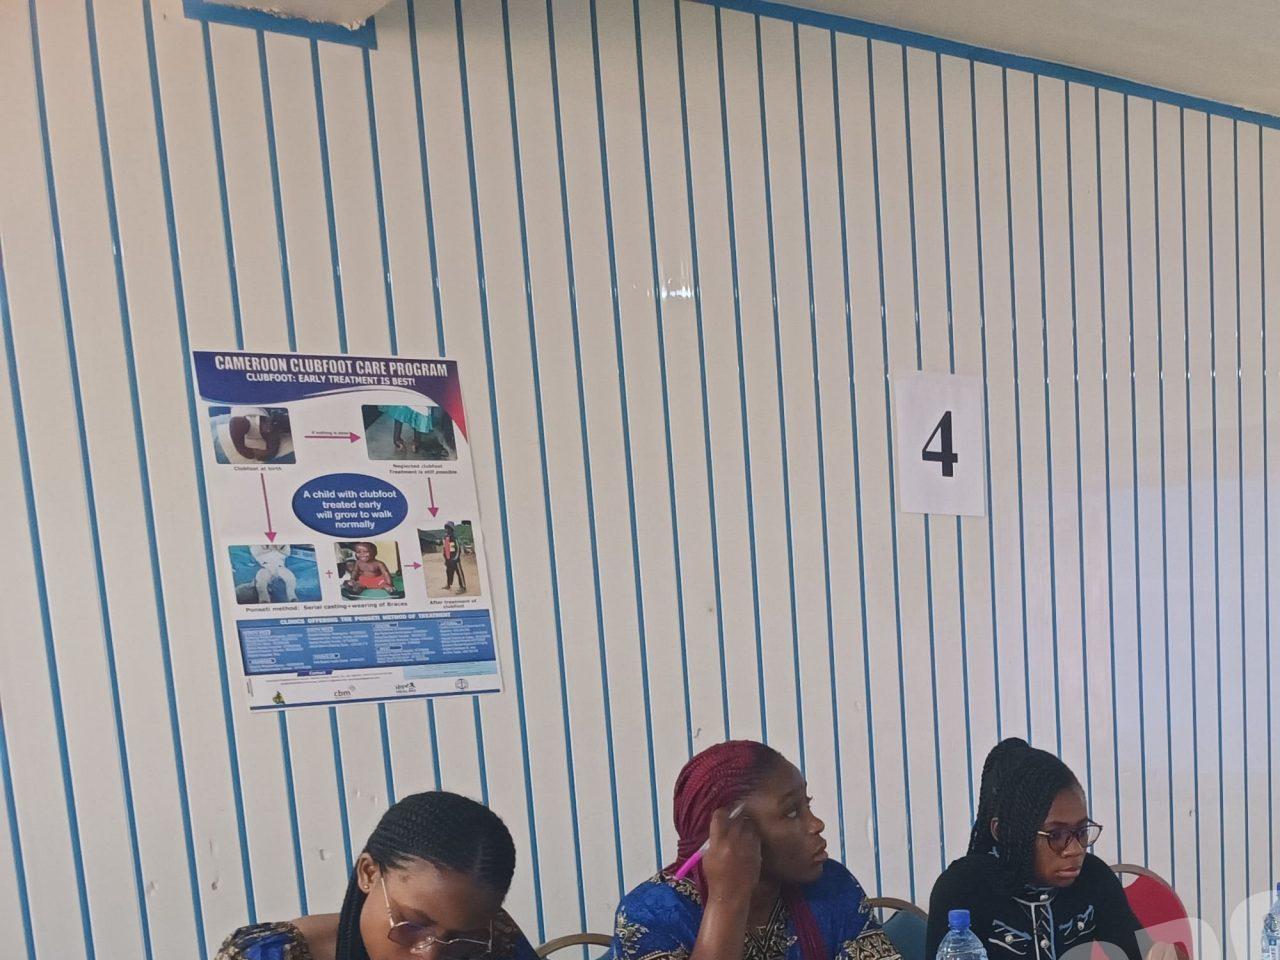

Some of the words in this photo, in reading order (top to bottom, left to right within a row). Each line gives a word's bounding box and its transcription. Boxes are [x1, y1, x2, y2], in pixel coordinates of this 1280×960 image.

[215, 356, 287, 371] CAMEROON
[290, 358, 353, 374] CLUBFOOT
[356, 361, 387, 375] CARE
[390, 362, 448, 377] PROGRAM
[246, 373, 297, 383] CLUBFOOT:
[298, 374, 327, 384] EARLY
[328, 375, 378, 385] TREATMENT
[381, 377, 390, 385] IS
[392, 377, 416, 387] BEST!
[922, 410, 958, 478] 4
[303, 490, 311, 498] A
[312, 490, 336, 498] child
[337, 490, 357, 498] with
[359, 490, 397, 498] clubfoot
[322, 500, 356, 509] treated
[358, 501, 382, 510] early
[316, 510, 333, 519] will
[335, 512, 359, 521] grow
[360, 510, 369, 519] to
[371, 510, 393, 518] walk
[335, 519, 375, 530] normally
